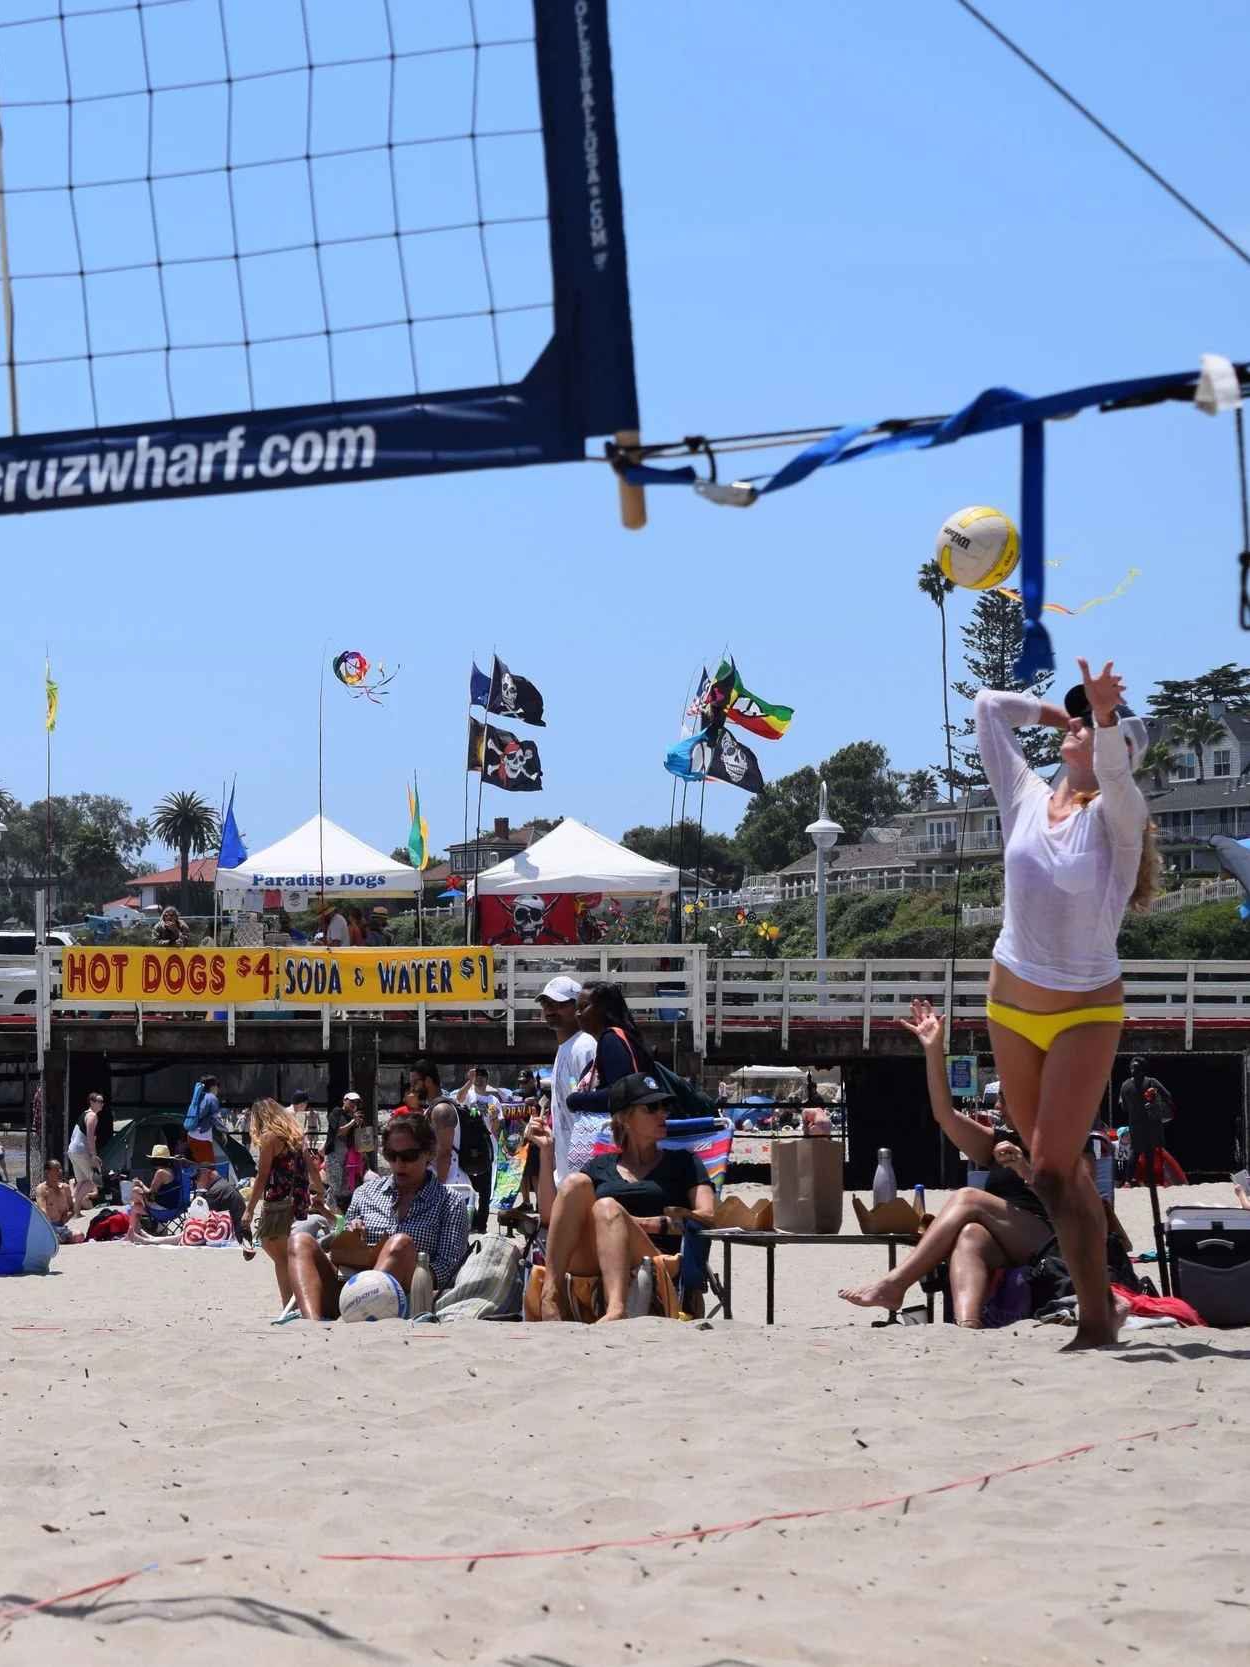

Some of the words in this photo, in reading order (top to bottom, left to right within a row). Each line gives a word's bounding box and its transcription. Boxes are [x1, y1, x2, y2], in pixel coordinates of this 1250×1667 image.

[252, 873, 335, 887] Paradise
[339, 873, 386, 889] Dogs
[67, 953, 129, 994] HOT
[141, 954, 226, 995] DOGS
[236, 952, 274, 995] $4
[284, 956, 342, 995] SODA
[354, 966, 365, 987] &
[376, 957, 453, 994] WATER
[460, 954, 488, 994] $1
